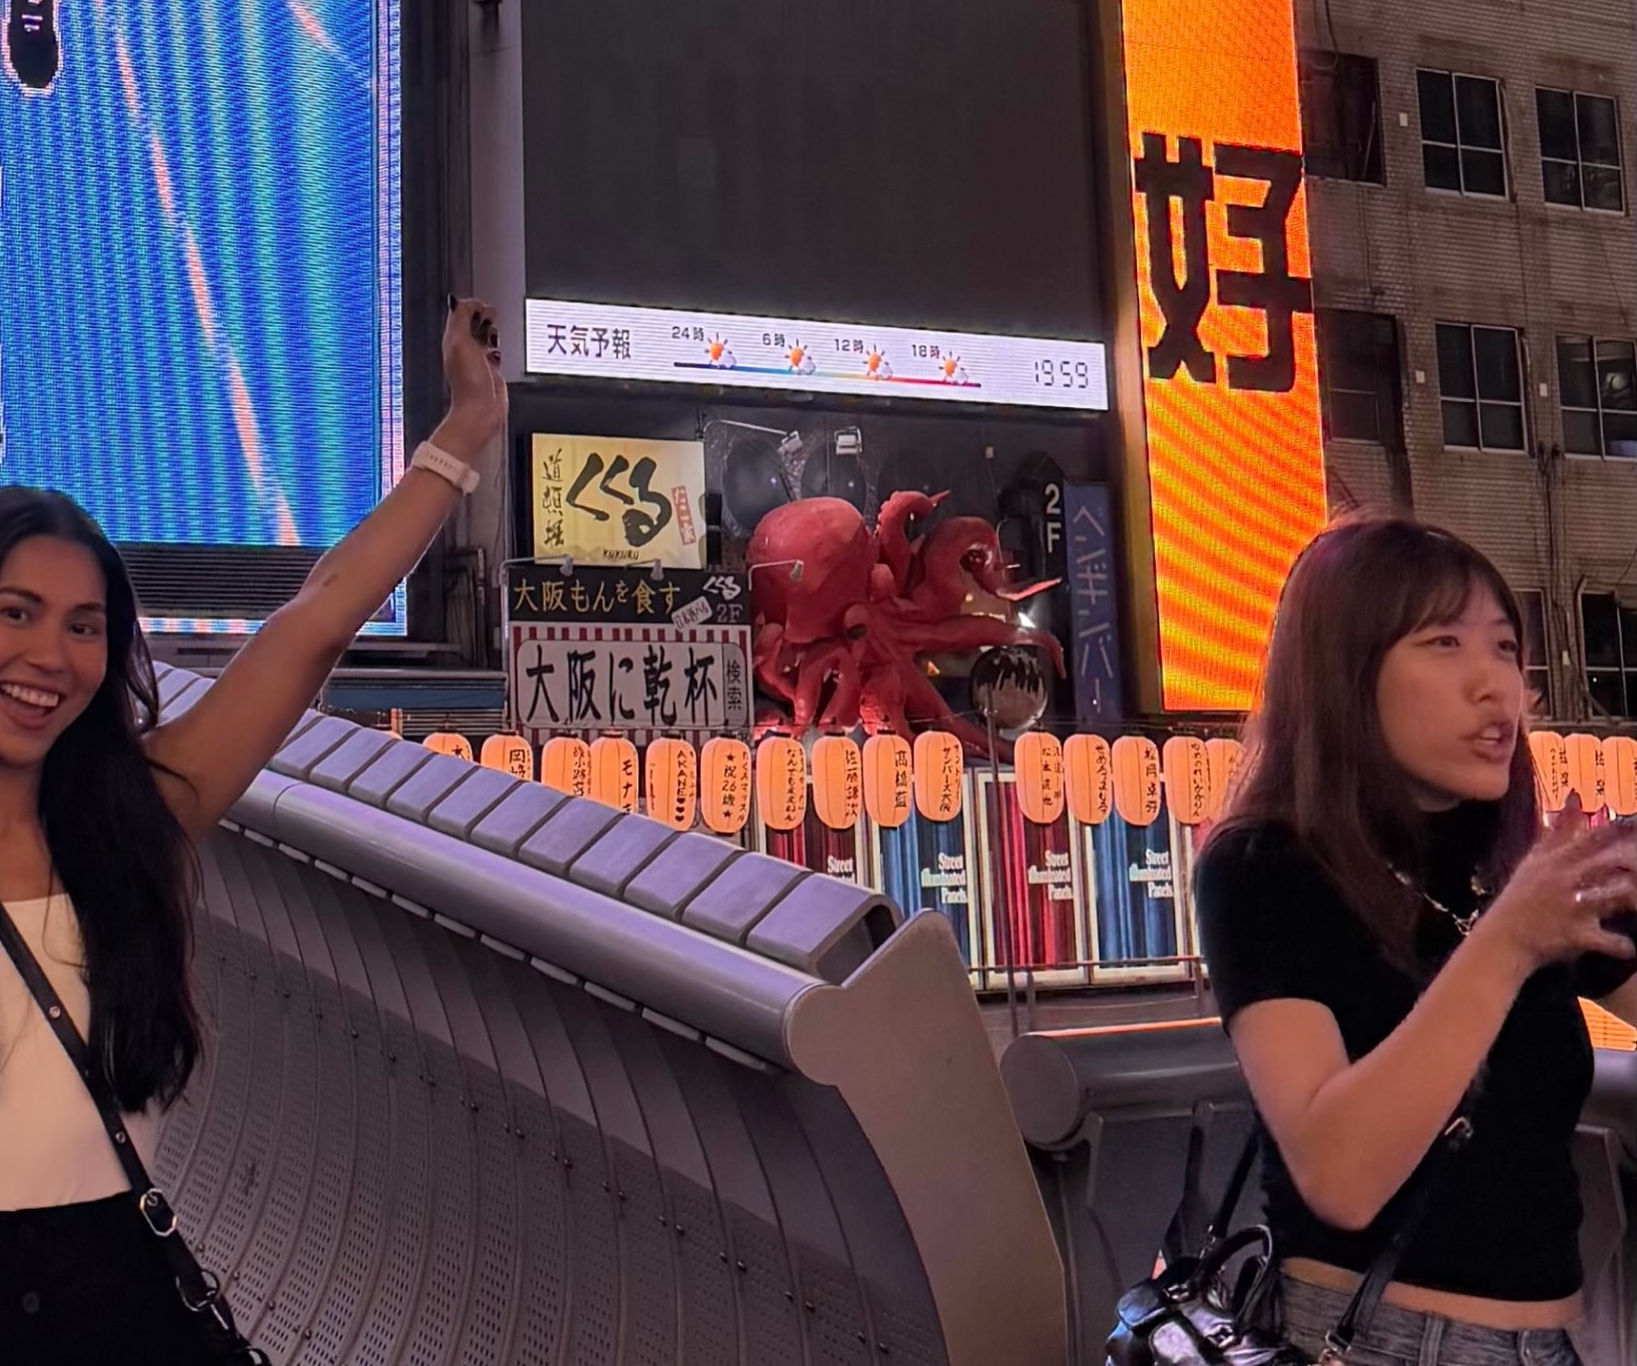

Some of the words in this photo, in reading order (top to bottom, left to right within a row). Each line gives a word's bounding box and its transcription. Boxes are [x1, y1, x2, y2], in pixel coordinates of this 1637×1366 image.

[547, 323, 631, 360] 天気予報
[671, 326, 704, 342] 24時
[762, 334, 785, 348] 6時
[835, 338, 864, 354] 12時
[912, 344, 941, 360] 18時
[565, 452, 673, 547] くくる
[603, 548, 640, 561] KUKURU
[514, 578, 681, 614] 大阪もんを食す
[716, 603, 744, 623] 2F
[526, 644, 718, 726] 大阪に乾杯
